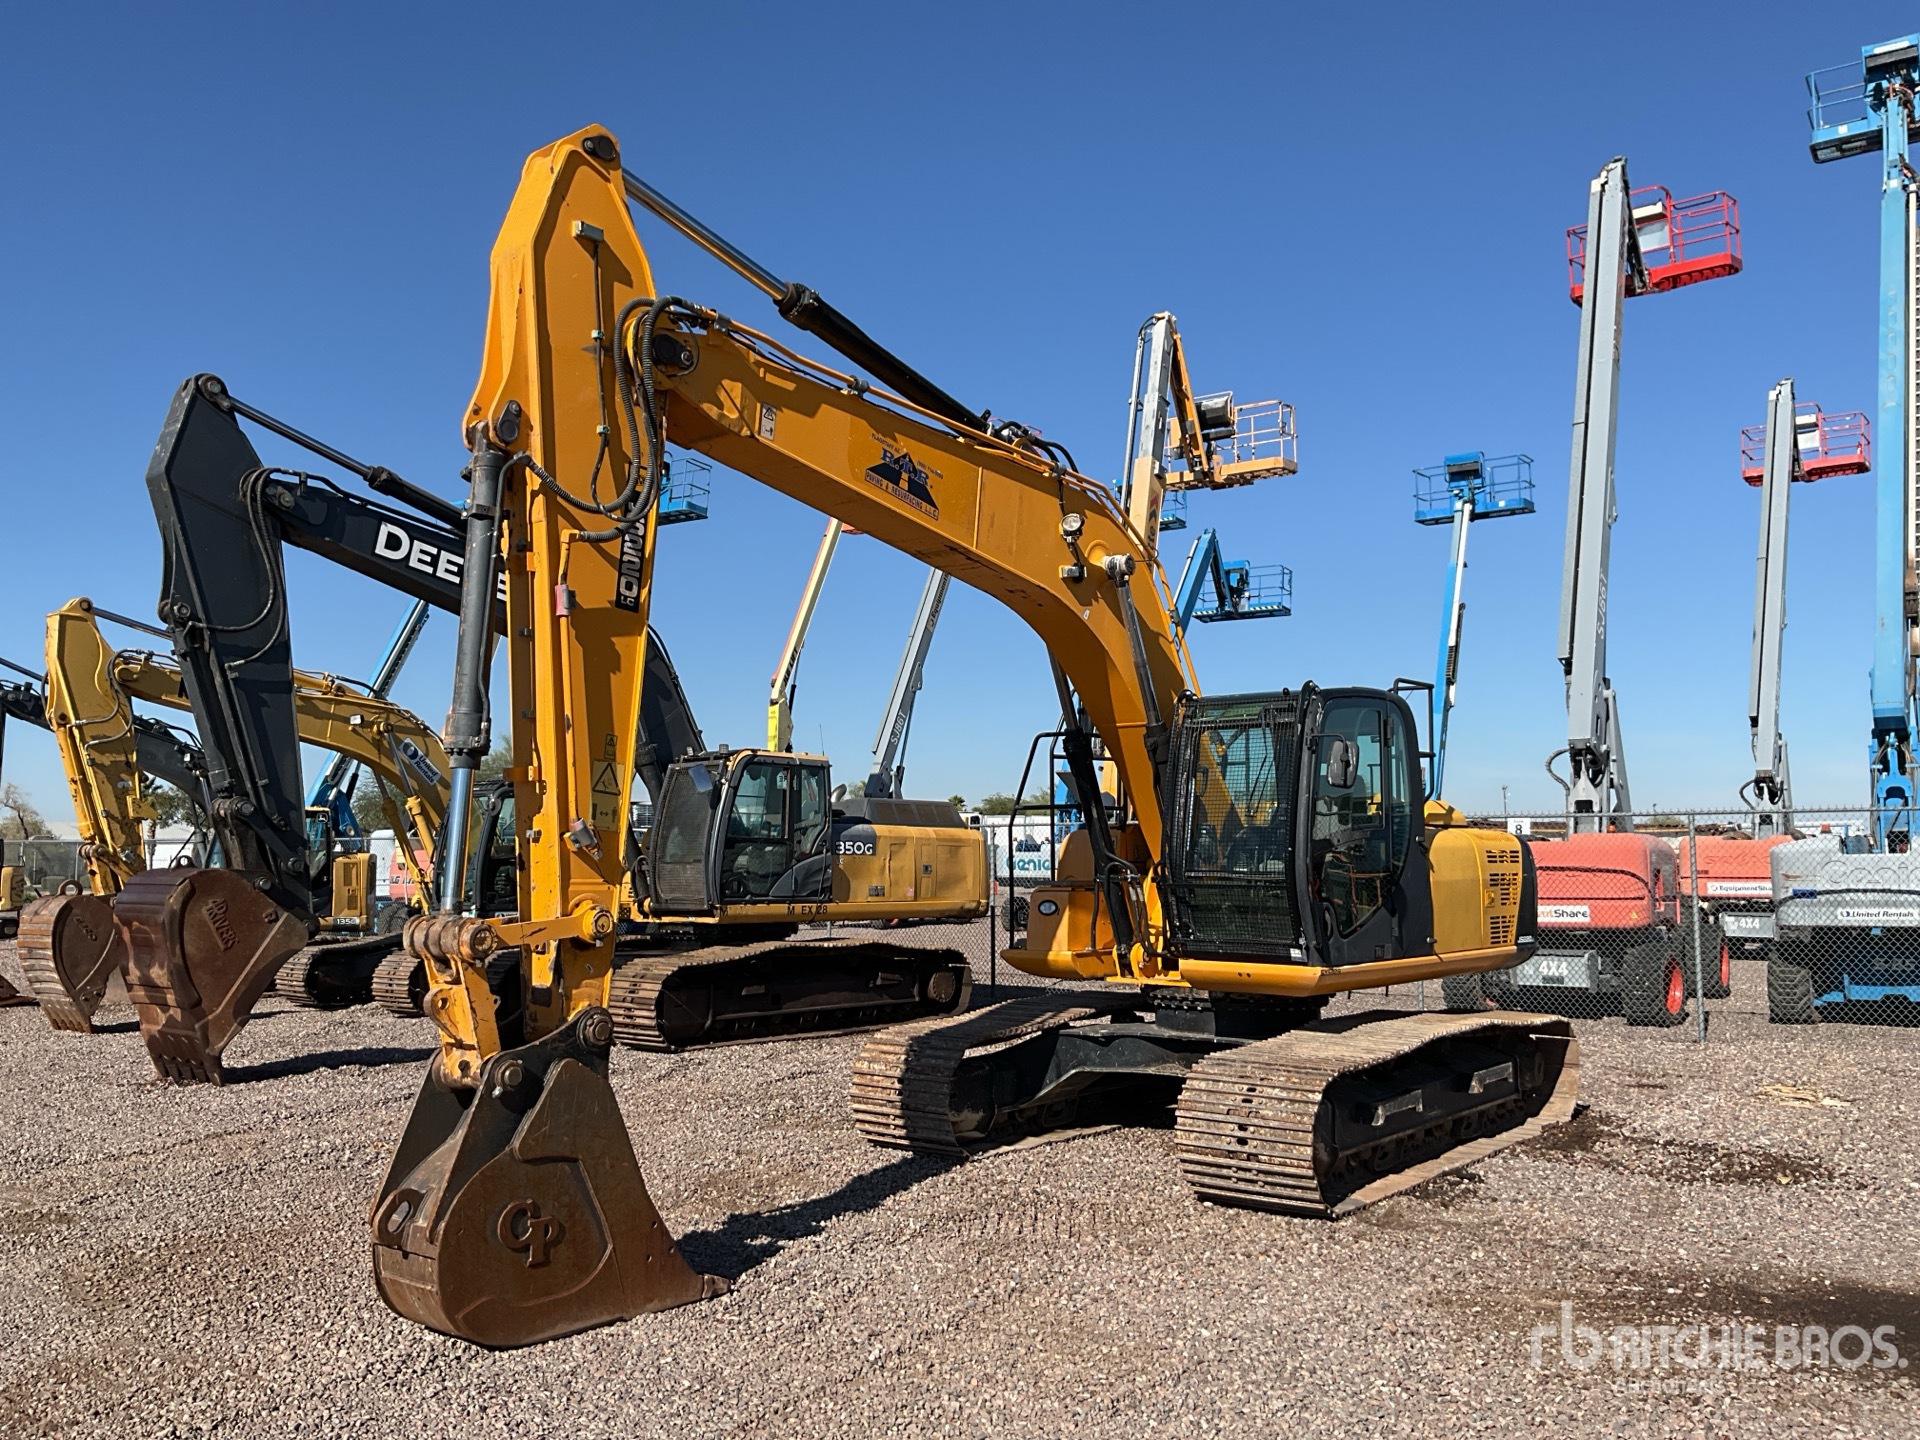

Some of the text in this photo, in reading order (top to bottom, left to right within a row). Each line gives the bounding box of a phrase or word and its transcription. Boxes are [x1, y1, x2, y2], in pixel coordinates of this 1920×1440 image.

[866, 470, 883, 488] PAVING
[891, 483, 923, 510] RESURFACING
[375, 521, 506, 601] DEE
[890, 708, 906, 746] SJ86T
[413, 760, 435, 783] Rentals
[418, 755, 439, 777] United
[1514, 823, 1523, 835] 8
[835, 841, 873, 855] 350G
[1739, 917, 1760, 929] 4X4
[1852, 910, 1914, 919] United Rentals
[1538, 960, 1569, 976] 4X4
